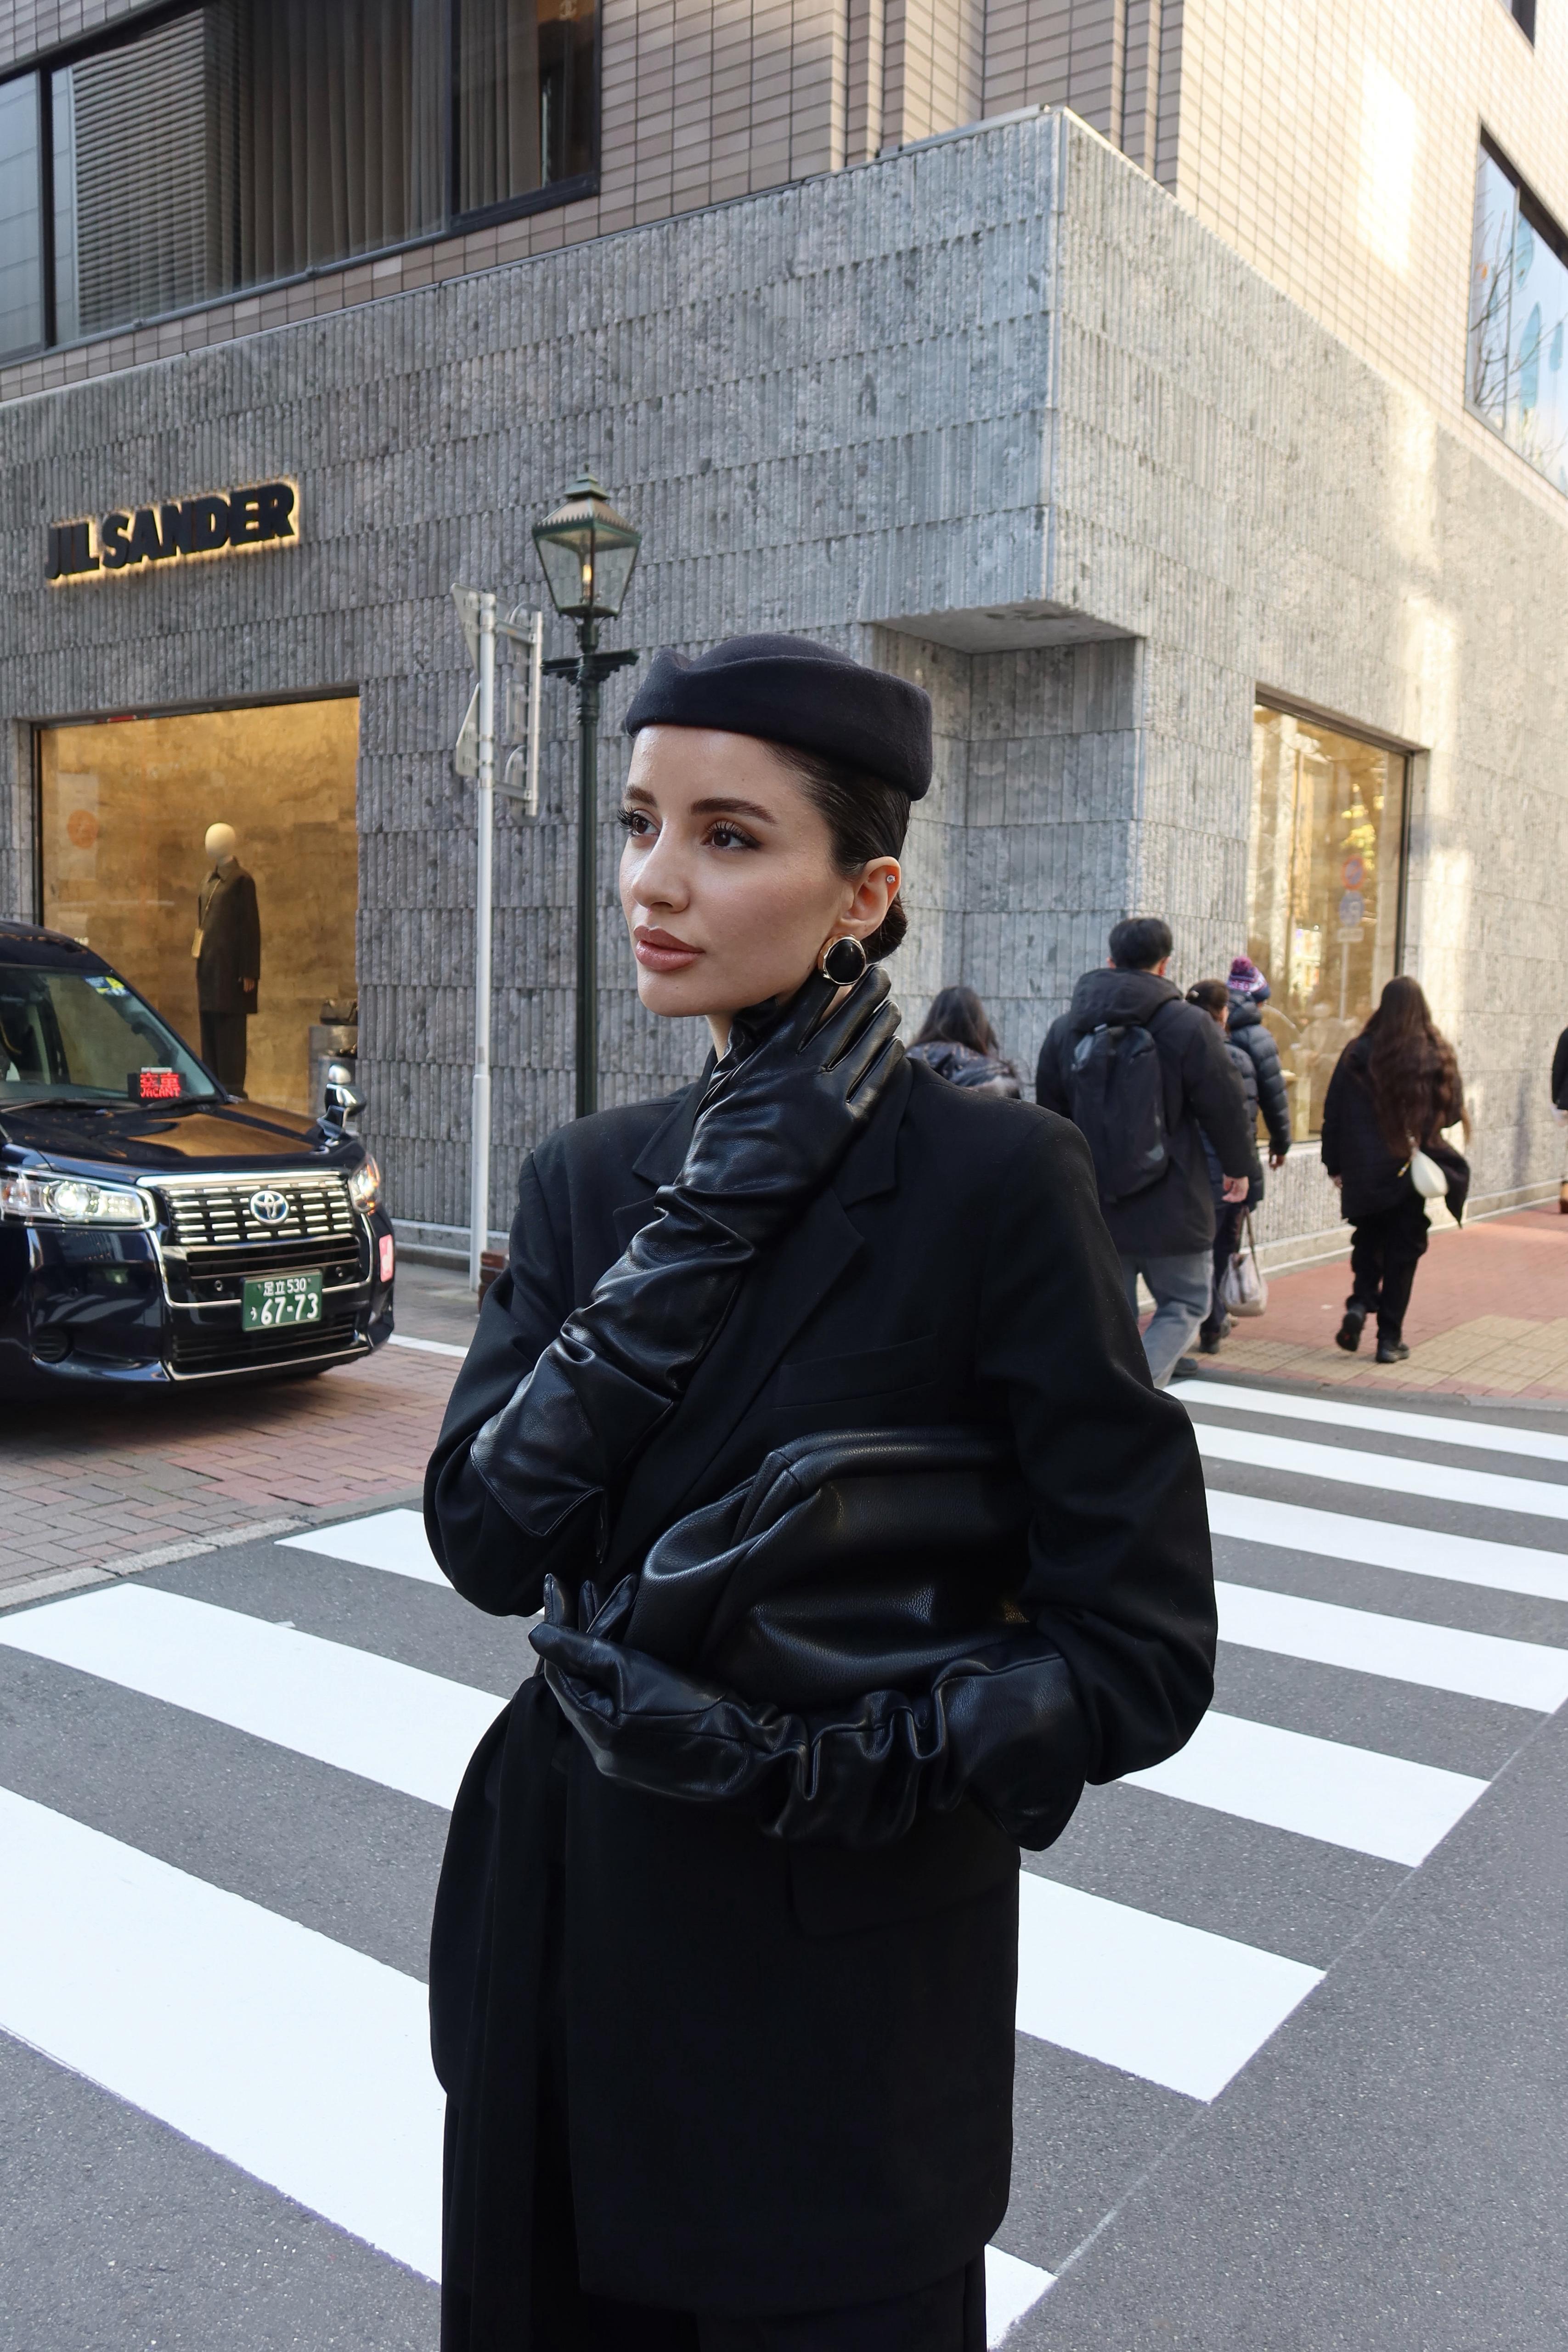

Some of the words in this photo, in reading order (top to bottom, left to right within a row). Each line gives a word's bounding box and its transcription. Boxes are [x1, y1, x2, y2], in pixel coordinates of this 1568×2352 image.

[46, 522, 99, 579] JIL
[102, 483, 294, 569] SANDER
[263, 1281, 285, 1297] 足立
[287, 1278, 306, 1294] 530
[261, 1293, 318, 1325] 67-73
